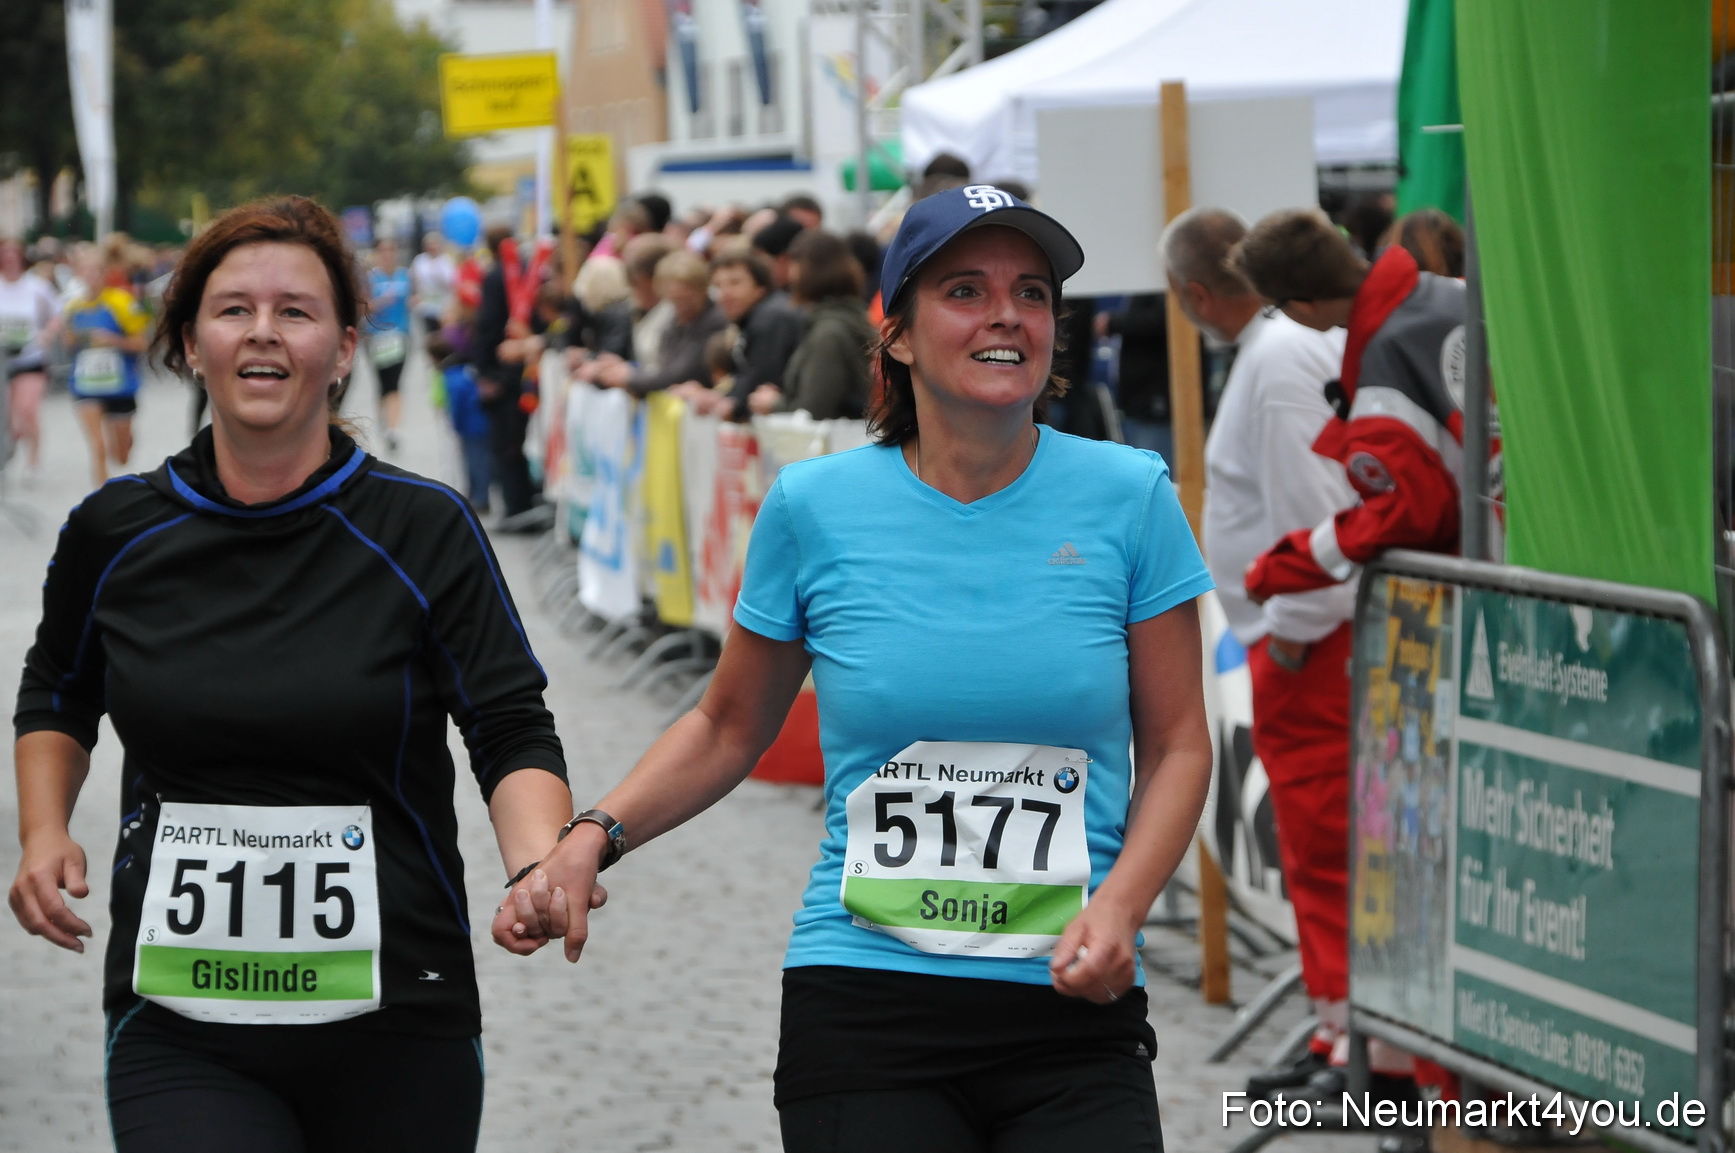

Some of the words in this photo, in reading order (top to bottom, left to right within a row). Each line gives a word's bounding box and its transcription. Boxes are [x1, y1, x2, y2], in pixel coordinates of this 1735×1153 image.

[938, 763, 1045, 786] Neumarkt
[873, 790, 1062, 872] 5177
[1461, 766, 1514, 840] Mehr
[1515, 778, 1615, 870] Sicherheit
[160, 825, 227, 846] PARTL
[232, 828, 333, 849] Neumarkt
[854, 862, 863, 874] S
[166, 858, 355, 940] 5115
[920, 889, 1008, 930] Sonja
[1460, 855, 1492, 928] für
[1492, 866, 1520, 937] Ihr
[1521, 877, 1587, 960] Event!
[146, 928, 155, 942] S
[191, 959, 318, 993] Gislinde
